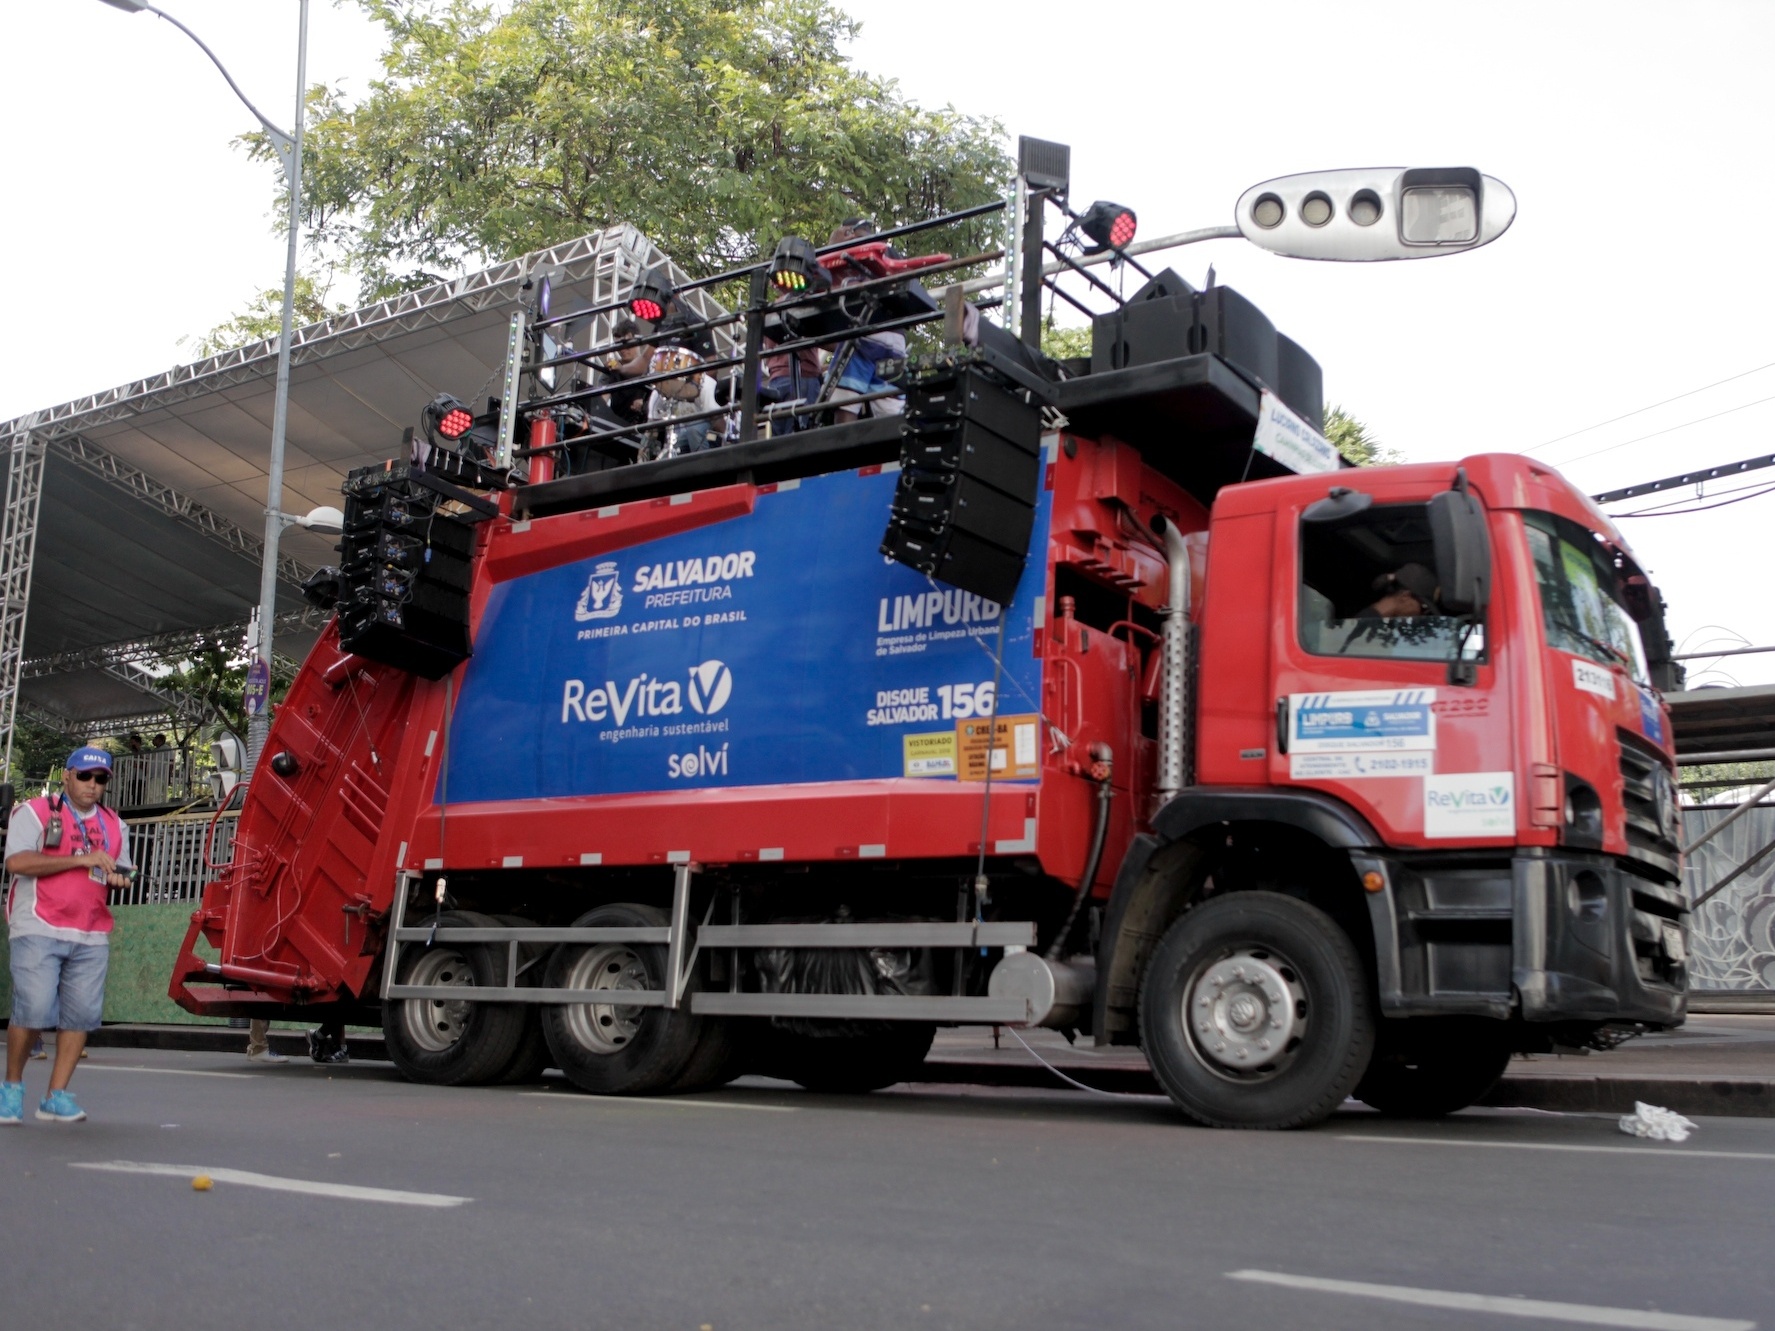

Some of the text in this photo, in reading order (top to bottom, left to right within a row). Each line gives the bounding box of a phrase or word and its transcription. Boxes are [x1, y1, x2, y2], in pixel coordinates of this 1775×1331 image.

[632, 550, 756, 593] SALVADOR
[645, 585, 732, 609] PREFEITURA
[577, 610, 747, 640] PRIMEIRA CAPITAL DO BRASIL
[876, 634, 914, 647] Empresa
[915, 633, 927, 642] de
[928, 628, 966, 641] Limpeza
[876, 643, 927, 657] de Salvador
[561, 672, 683, 727] ReVita
[876, 687, 929, 708] DISQUE
[937, 681, 998, 720] 156
[867, 704, 938, 726] SALVADOR
[599, 718, 729, 743] engenharia sustentável
[909, 737, 952, 747] VISTORIADO
